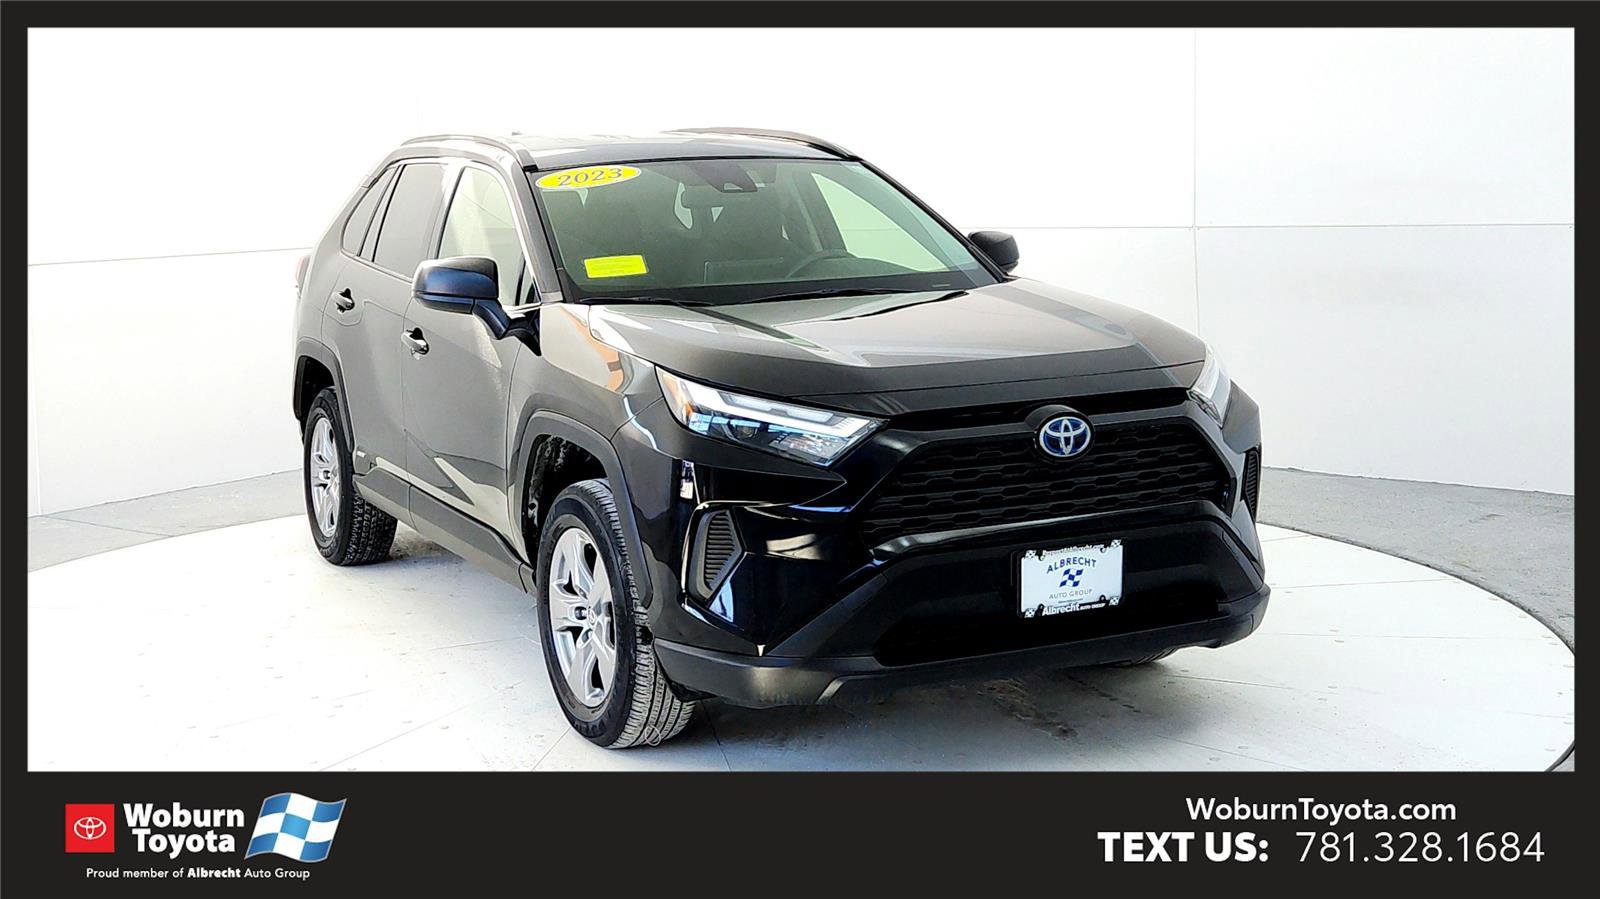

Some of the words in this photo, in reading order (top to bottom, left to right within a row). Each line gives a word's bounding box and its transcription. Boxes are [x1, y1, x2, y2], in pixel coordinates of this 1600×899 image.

[558, 168, 622, 186] 2023
[1047, 556, 1097, 574] ALBRECHT
[1048, 591, 1067, 599] AUTO
[1068, 588, 1092, 598] GROUP
[1042, 602, 1080, 616] Albrecht
